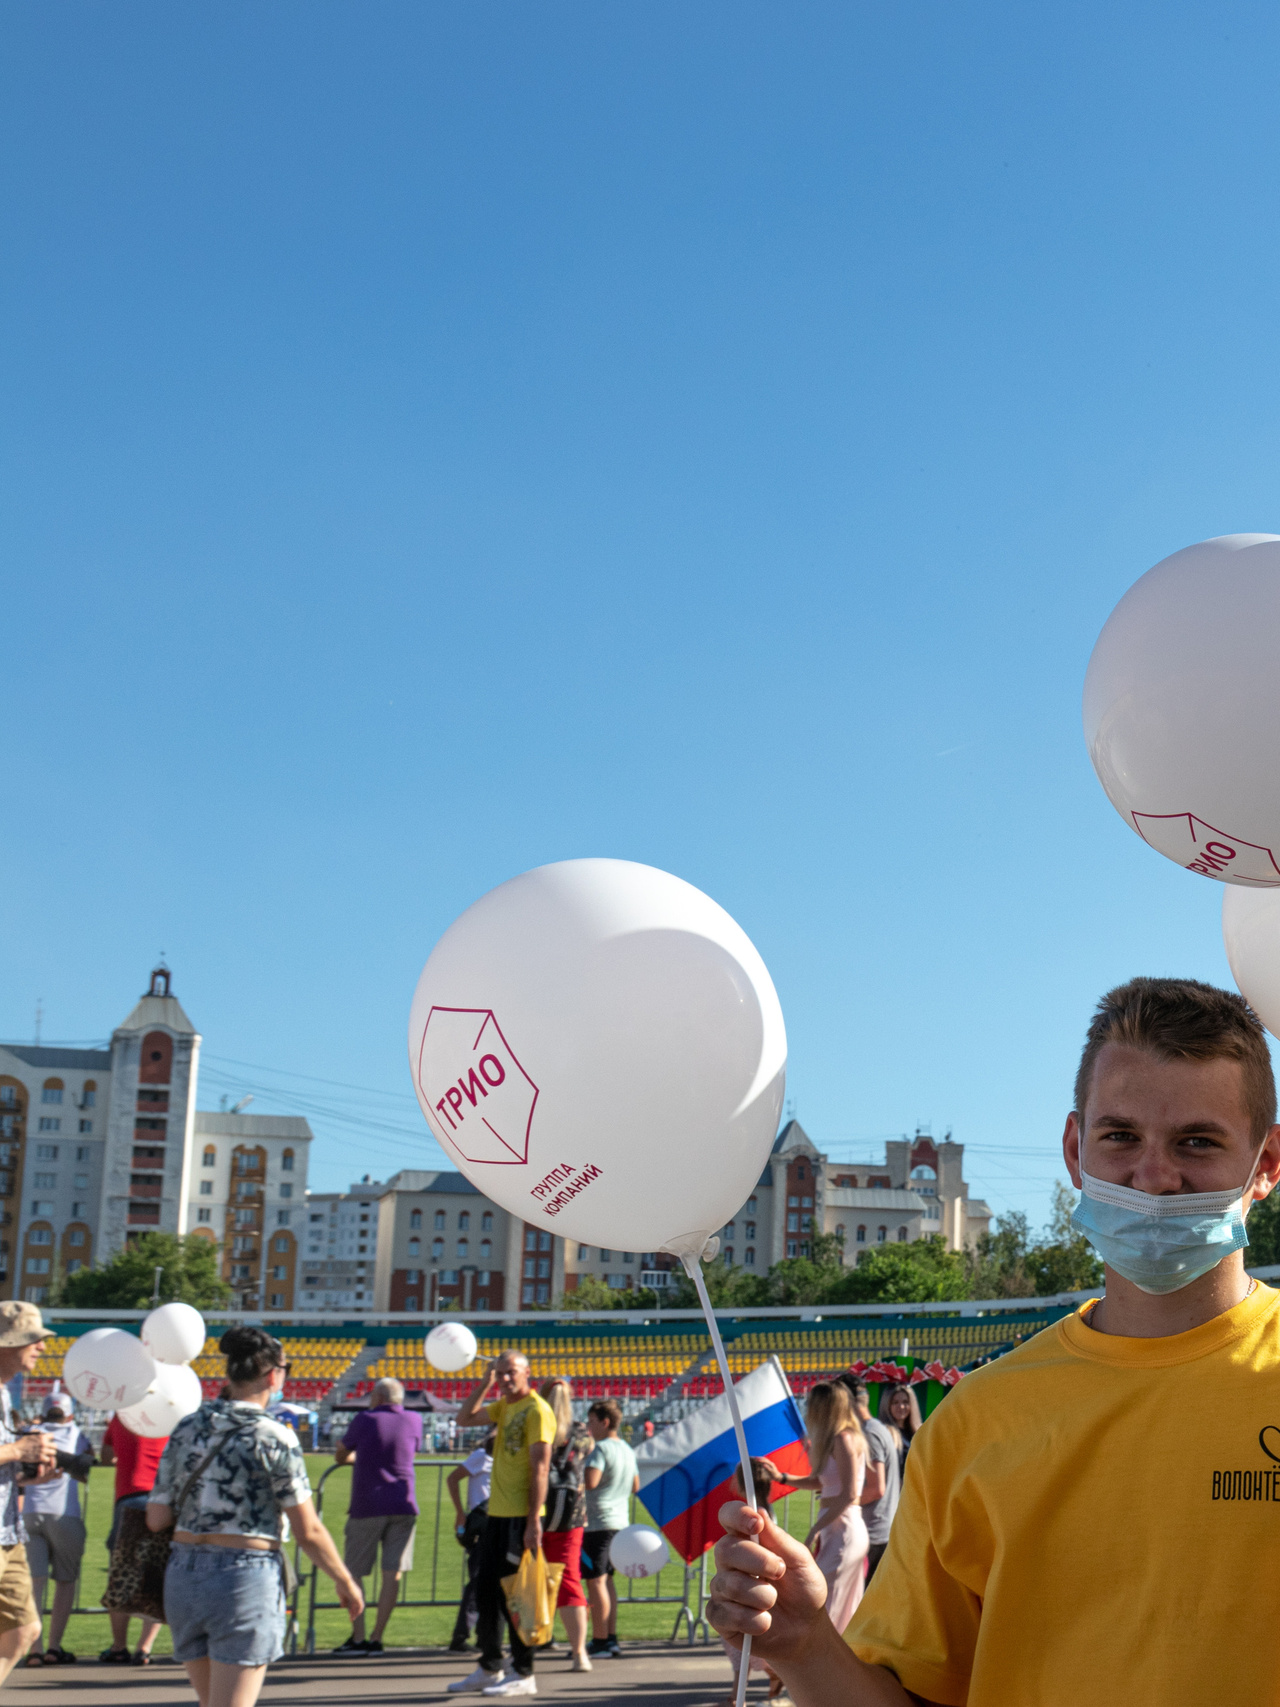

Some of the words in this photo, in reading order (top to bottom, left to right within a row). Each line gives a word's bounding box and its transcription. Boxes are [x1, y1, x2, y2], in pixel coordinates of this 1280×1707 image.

[435, 1053, 506, 1130] ТРИО
[530, 1163, 577, 1201] ГРУППА
[542, 1163, 604, 1217] КОМПАНИЙ
